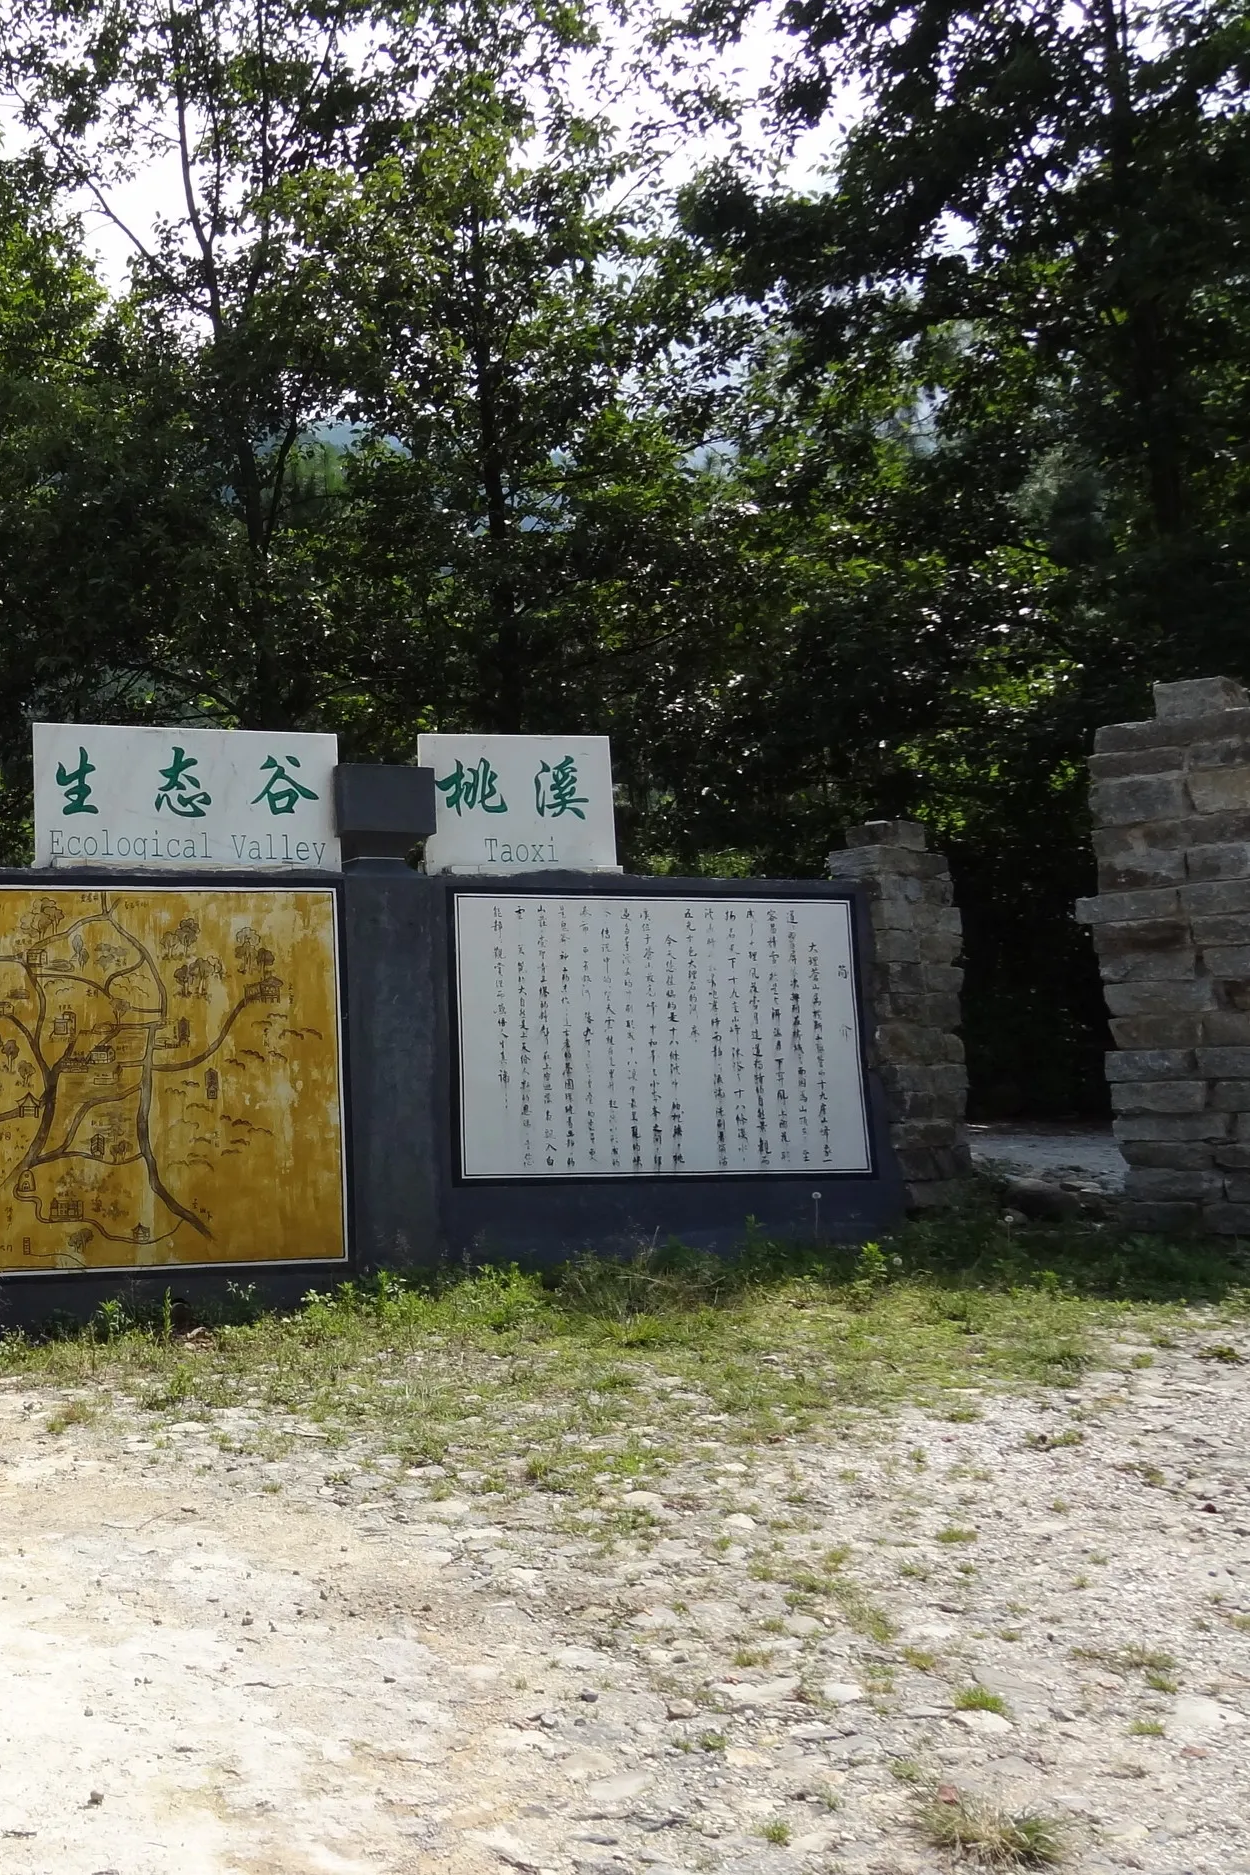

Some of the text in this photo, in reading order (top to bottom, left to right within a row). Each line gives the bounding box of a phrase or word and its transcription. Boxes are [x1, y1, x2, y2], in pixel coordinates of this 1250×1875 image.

[56, 746, 319, 818] 生态谷
[436, 755, 589, 821] 桃溪
[50, 829, 326, 866] Ecological Valley
[484, 837, 560, 864] Taoxi
